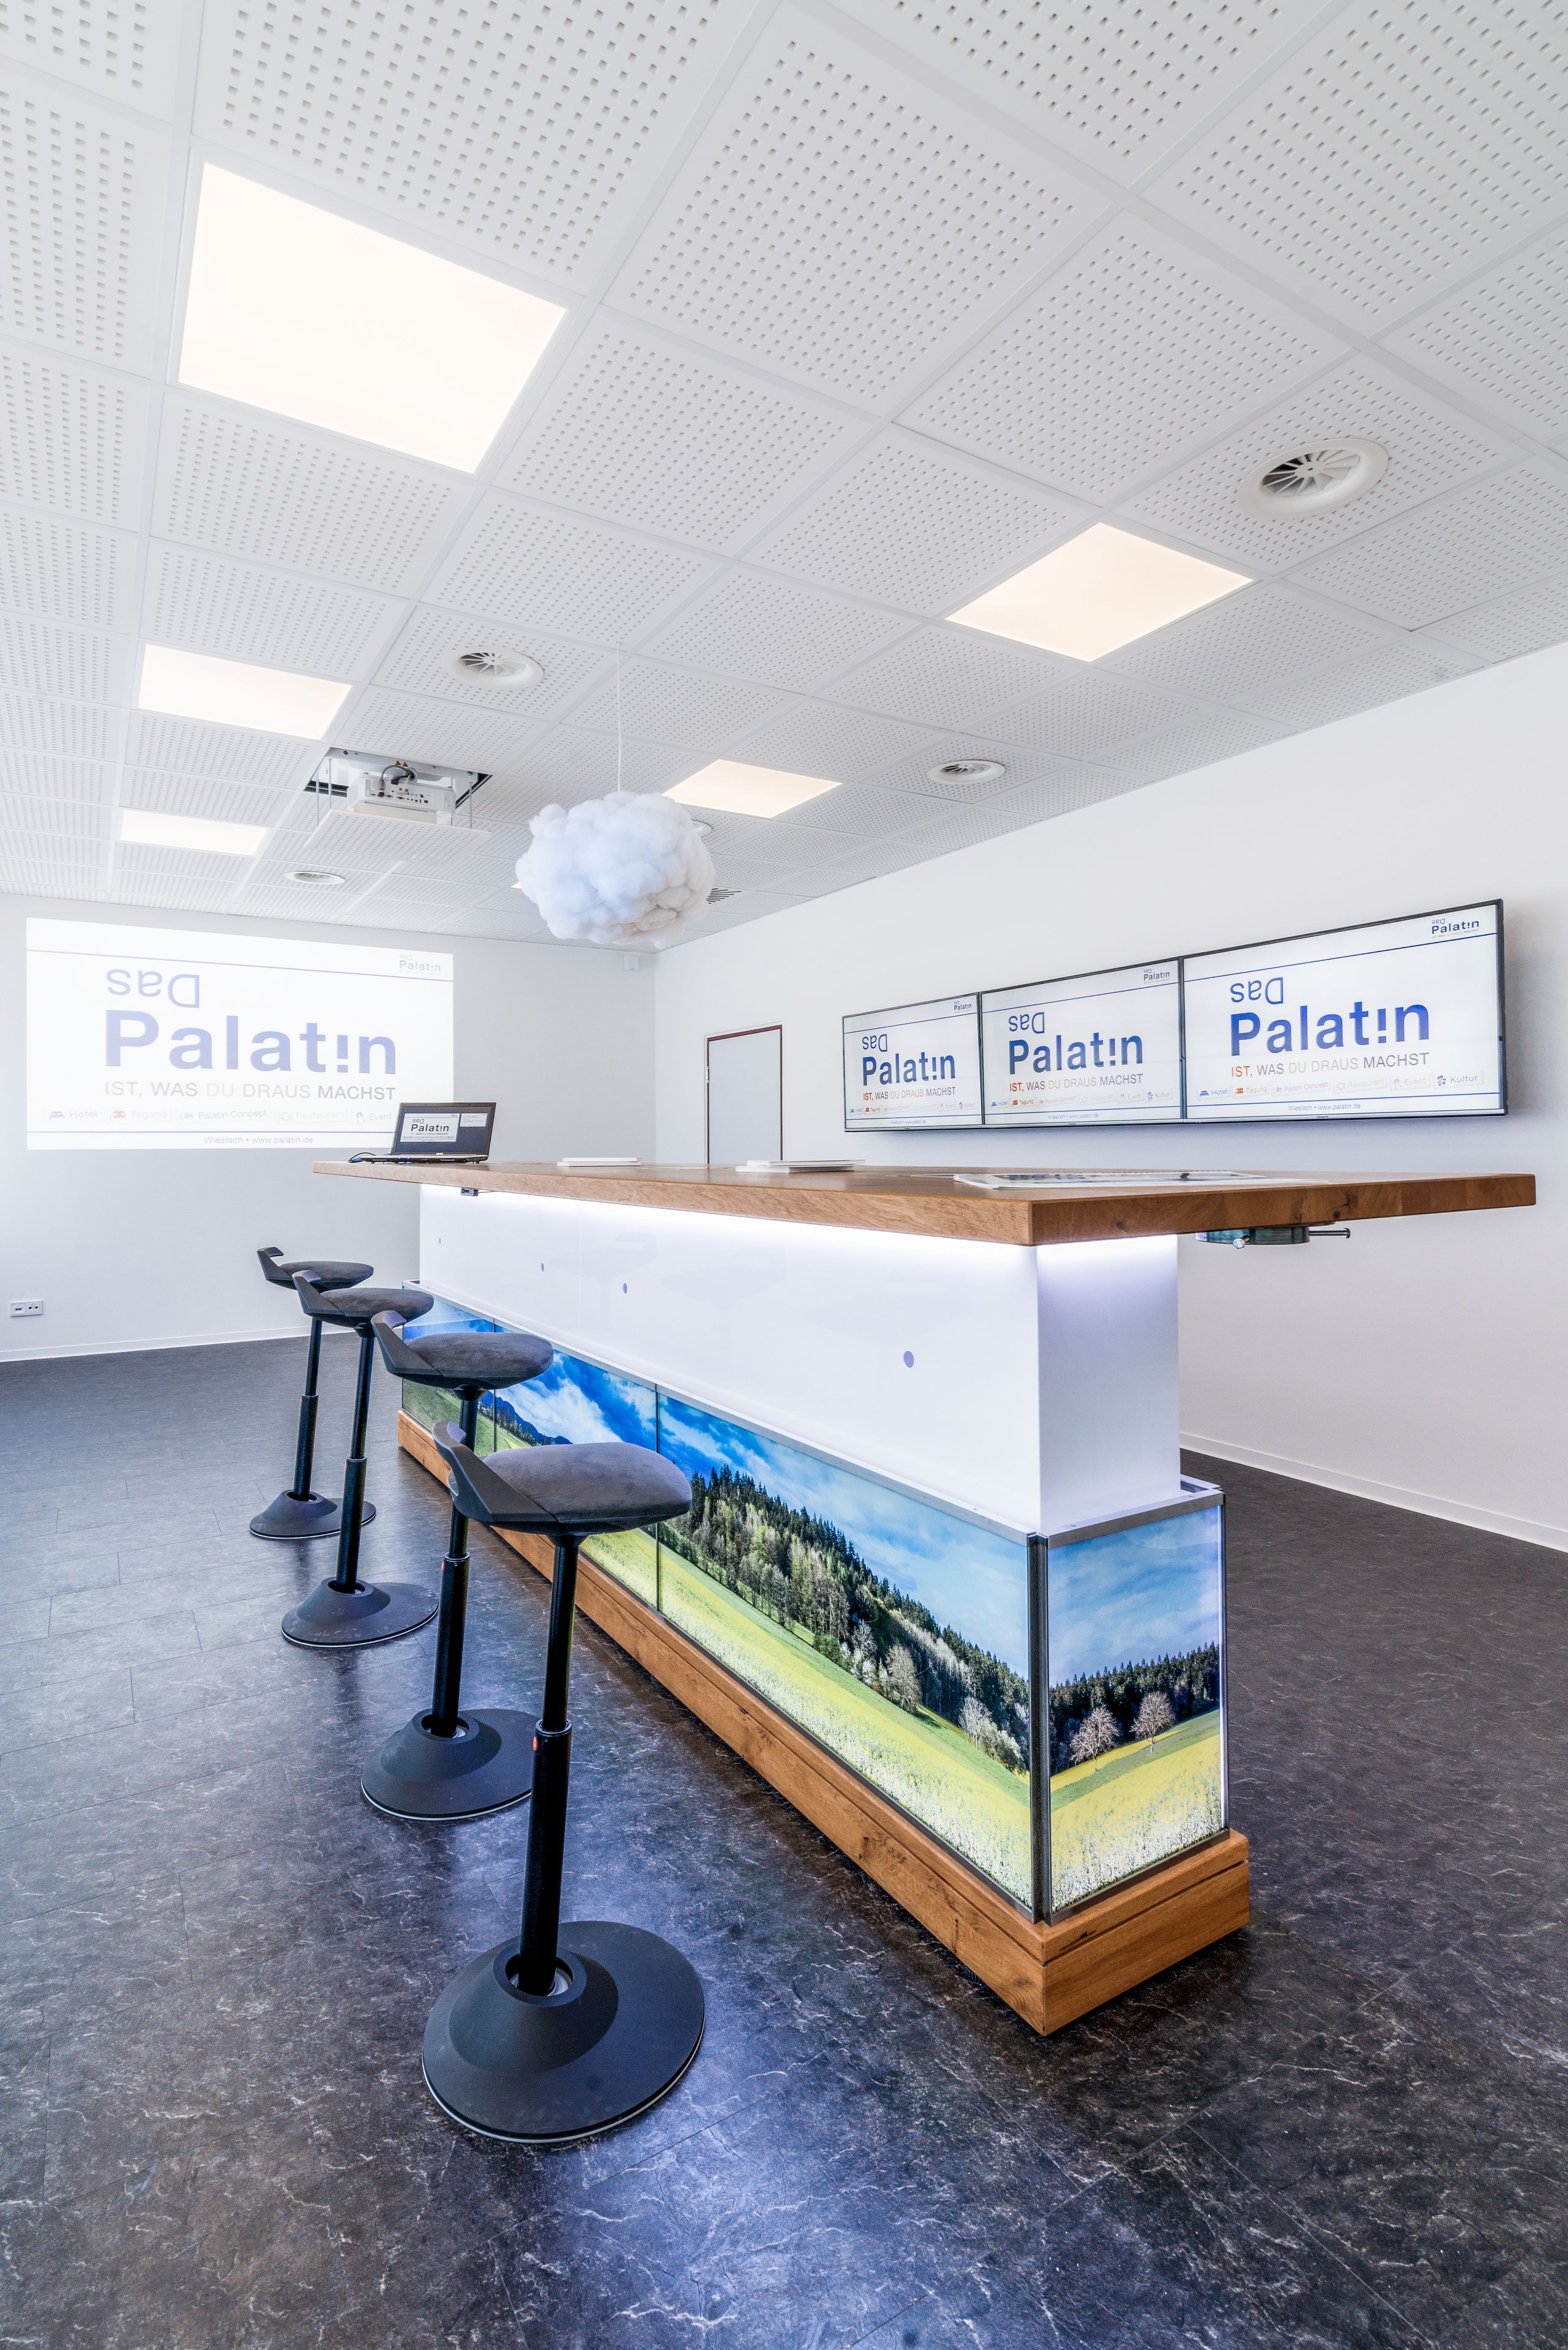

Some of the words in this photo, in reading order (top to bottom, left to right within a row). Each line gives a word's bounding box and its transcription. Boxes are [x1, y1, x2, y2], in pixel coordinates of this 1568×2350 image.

[106, 969, 200, 1009] Das
[1230, 977, 1283, 1005] Das
[1008, 1012, 1045, 1034] Das
[1230, 1001, 1430, 1056] Palat!n
[106, 1009, 396, 1075] Palat!n
[862, 1034, 887, 1053] Das
[1009, 1032, 1143, 1075] Palat!n
[862, 1051, 955, 1086] Palat!n
[1231, 1065, 1252, 1078] IST,
[1256, 1063, 1284, 1075] WAS
[1289, 1062, 1306, 1074] DU
[1312, 1058, 1359, 1073] DRAUS
[1363, 1053, 1430, 1069] MACHST
[1010, 1082, 1024, 1092] IST,
[1026, 1081, 1045, 1091] WAS
[1048, 1079, 1061, 1089] DU
[1064, 1077, 1097, 1089] DRAUS
[1100, 1073, 1143, 1086] MACHST
[1348, 1078, 1384, 1088] Restaurant
[1450, 1074, 1479, 1083] Kultur
[105, 1081, 142, 1099] IST,
[151, 1082, 198, 1097] WAS
[206, 1083, 235, 1097] DU
[242, 1083, 311, 1099] DRAUS
[317, 1086, 396, 1100] MACHST
[863, 1092, 873, 1102] IST,
[875, 1091, 889, 1100] WAS
[890, 1091, 899, 1099] DU
[902, 1089, 924, 1099] DRAUS
[926, 1087, 956, 1097] MACHST
[69, 1110, 98, 1119] Hotel
[132, 1110, 167, 1119] Tagung
[296, 1111, 344, 1119] Restaurant
